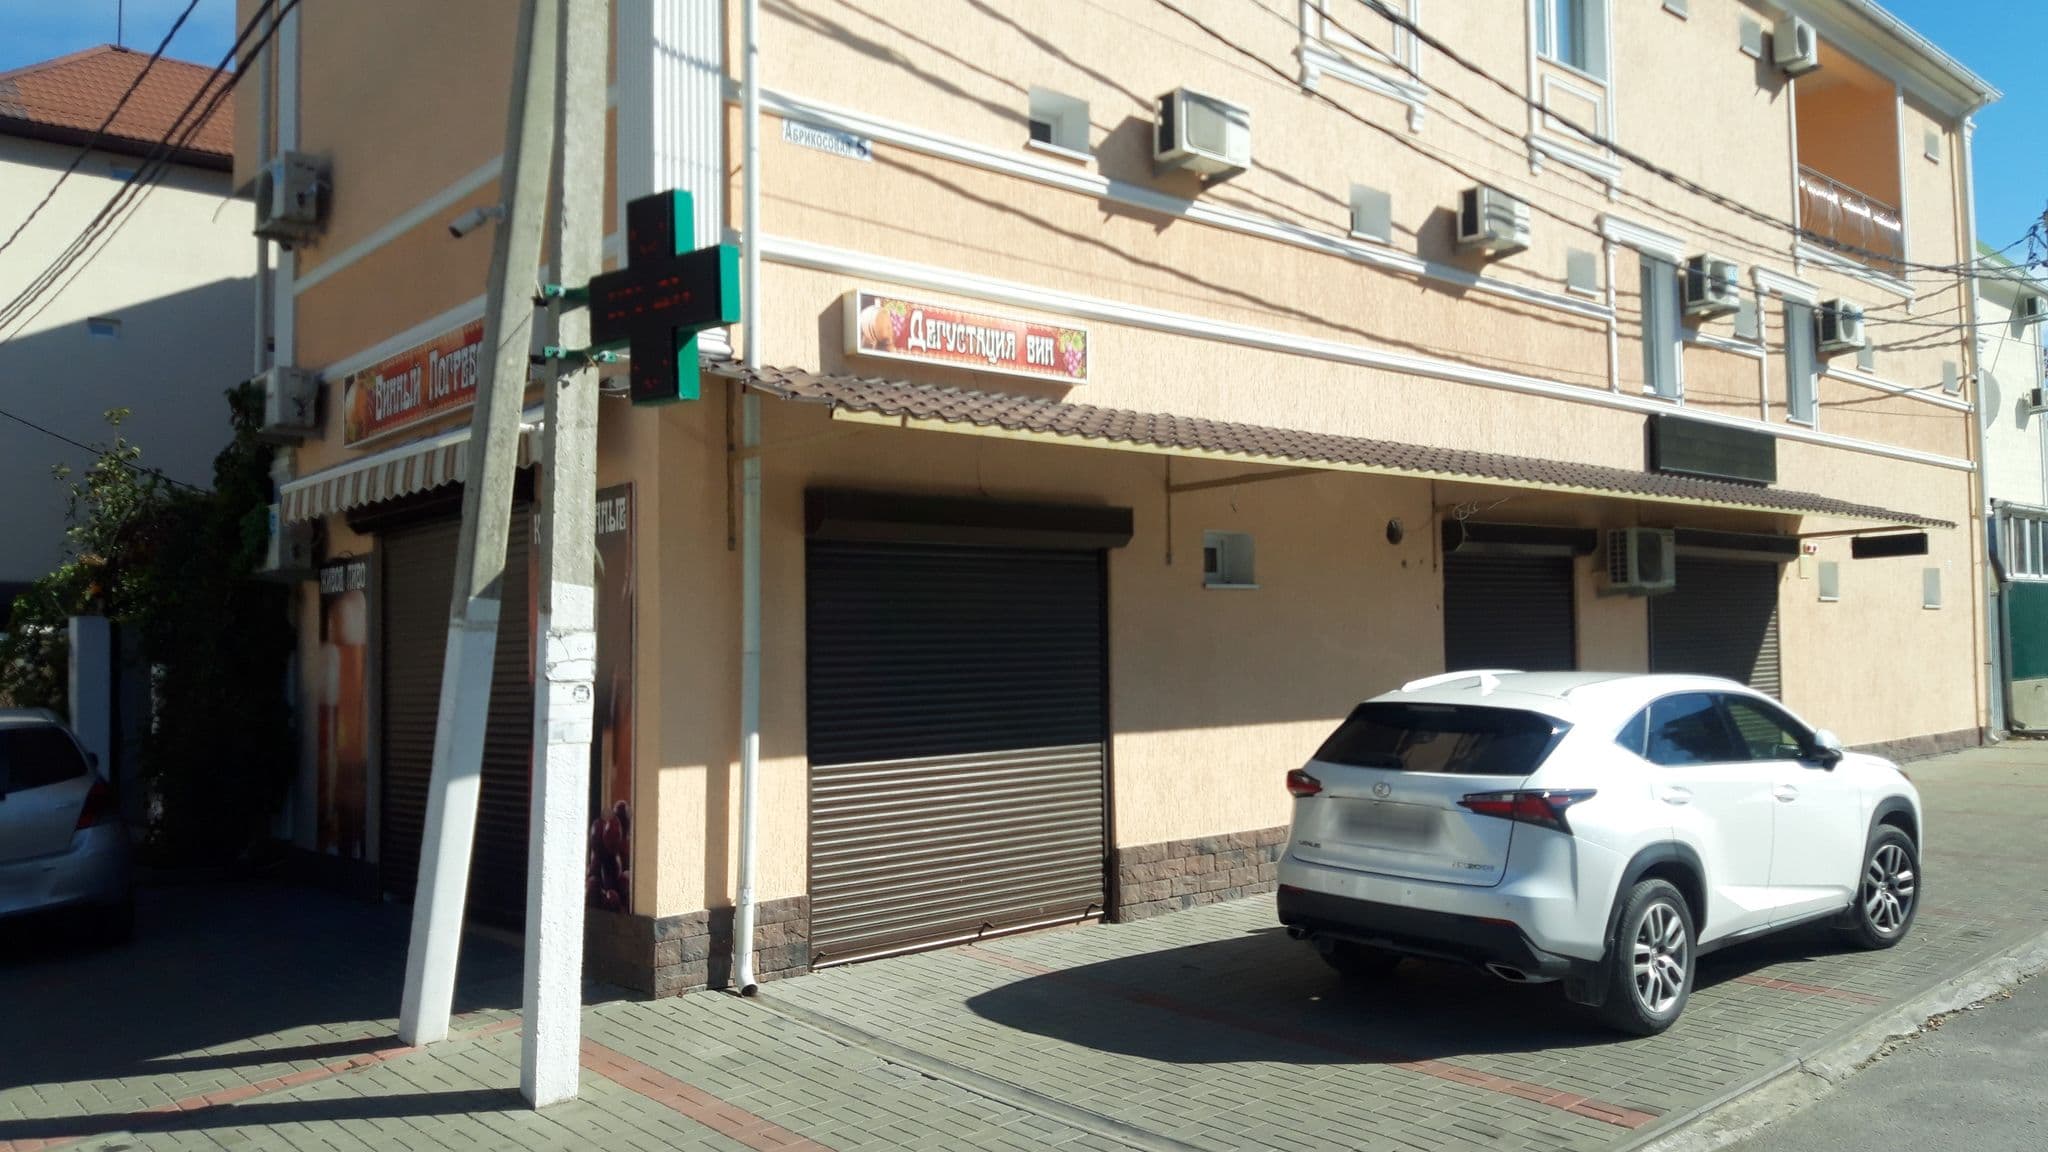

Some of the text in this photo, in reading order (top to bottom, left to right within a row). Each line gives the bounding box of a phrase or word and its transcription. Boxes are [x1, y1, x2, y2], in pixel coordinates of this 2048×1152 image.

[907, 308, 1056, 367] Дегустация вин
[375, 362, 422, 421] Винный
